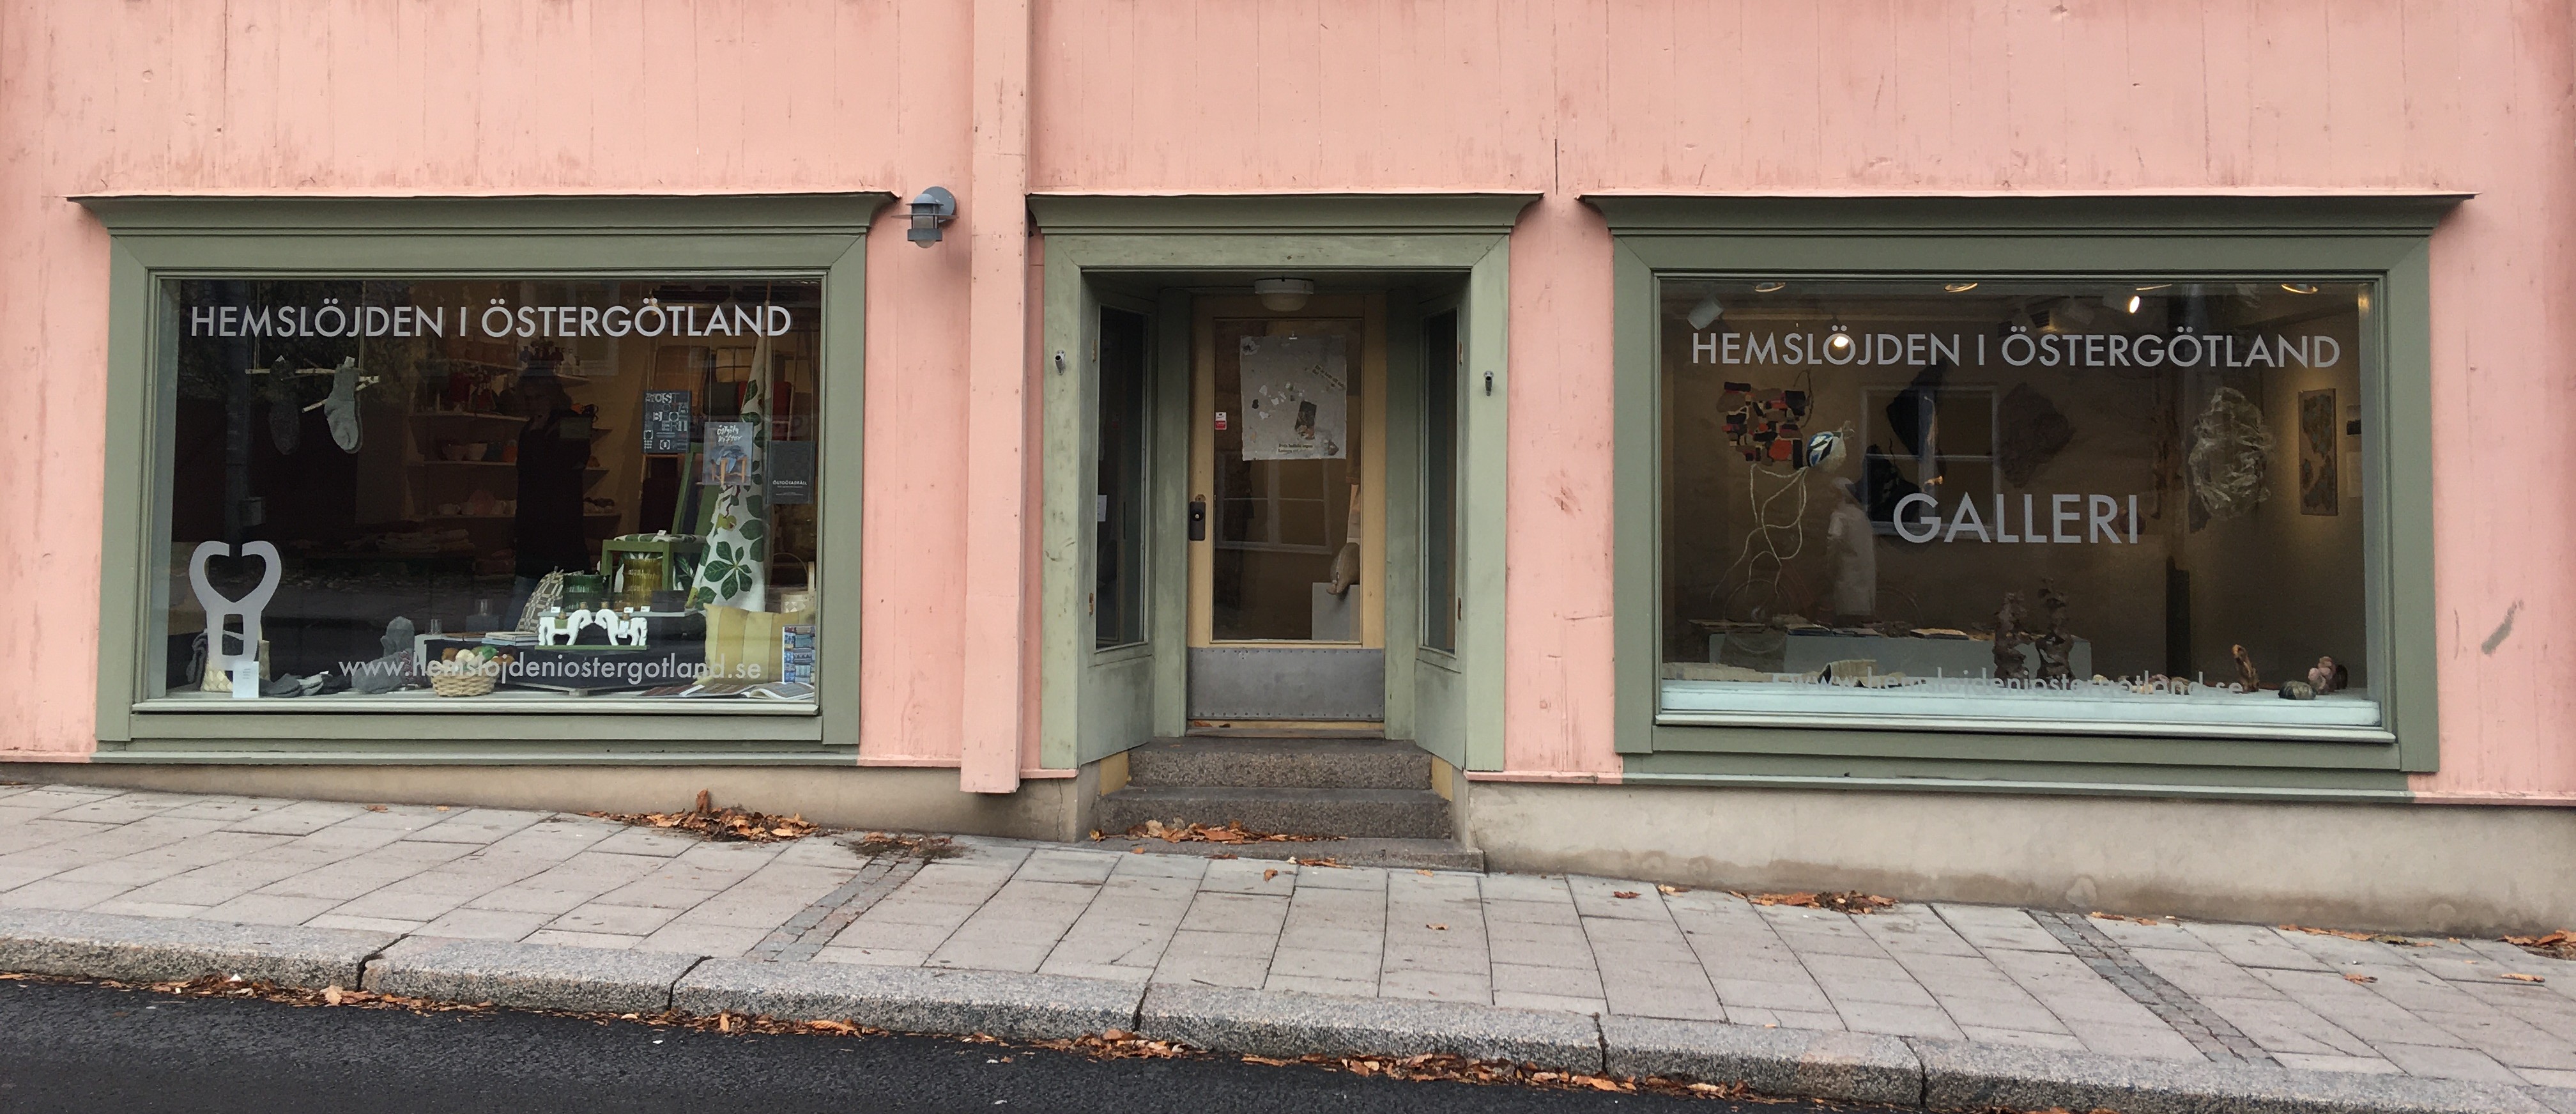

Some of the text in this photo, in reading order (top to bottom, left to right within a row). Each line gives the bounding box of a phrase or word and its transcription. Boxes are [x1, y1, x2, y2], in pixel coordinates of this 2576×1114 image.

[191, 298, 792, 338] HEMSLÖJDEN I ÖSTERGÖTLAND
[1692, 325, 2340, 368] HEMSLÖJDEN I ÖSTERGÖTLAND
[1893, 491, 2138, 544] GALLERI
[338, 651, 762, 685] www.hemslojdeniostergotland.se
